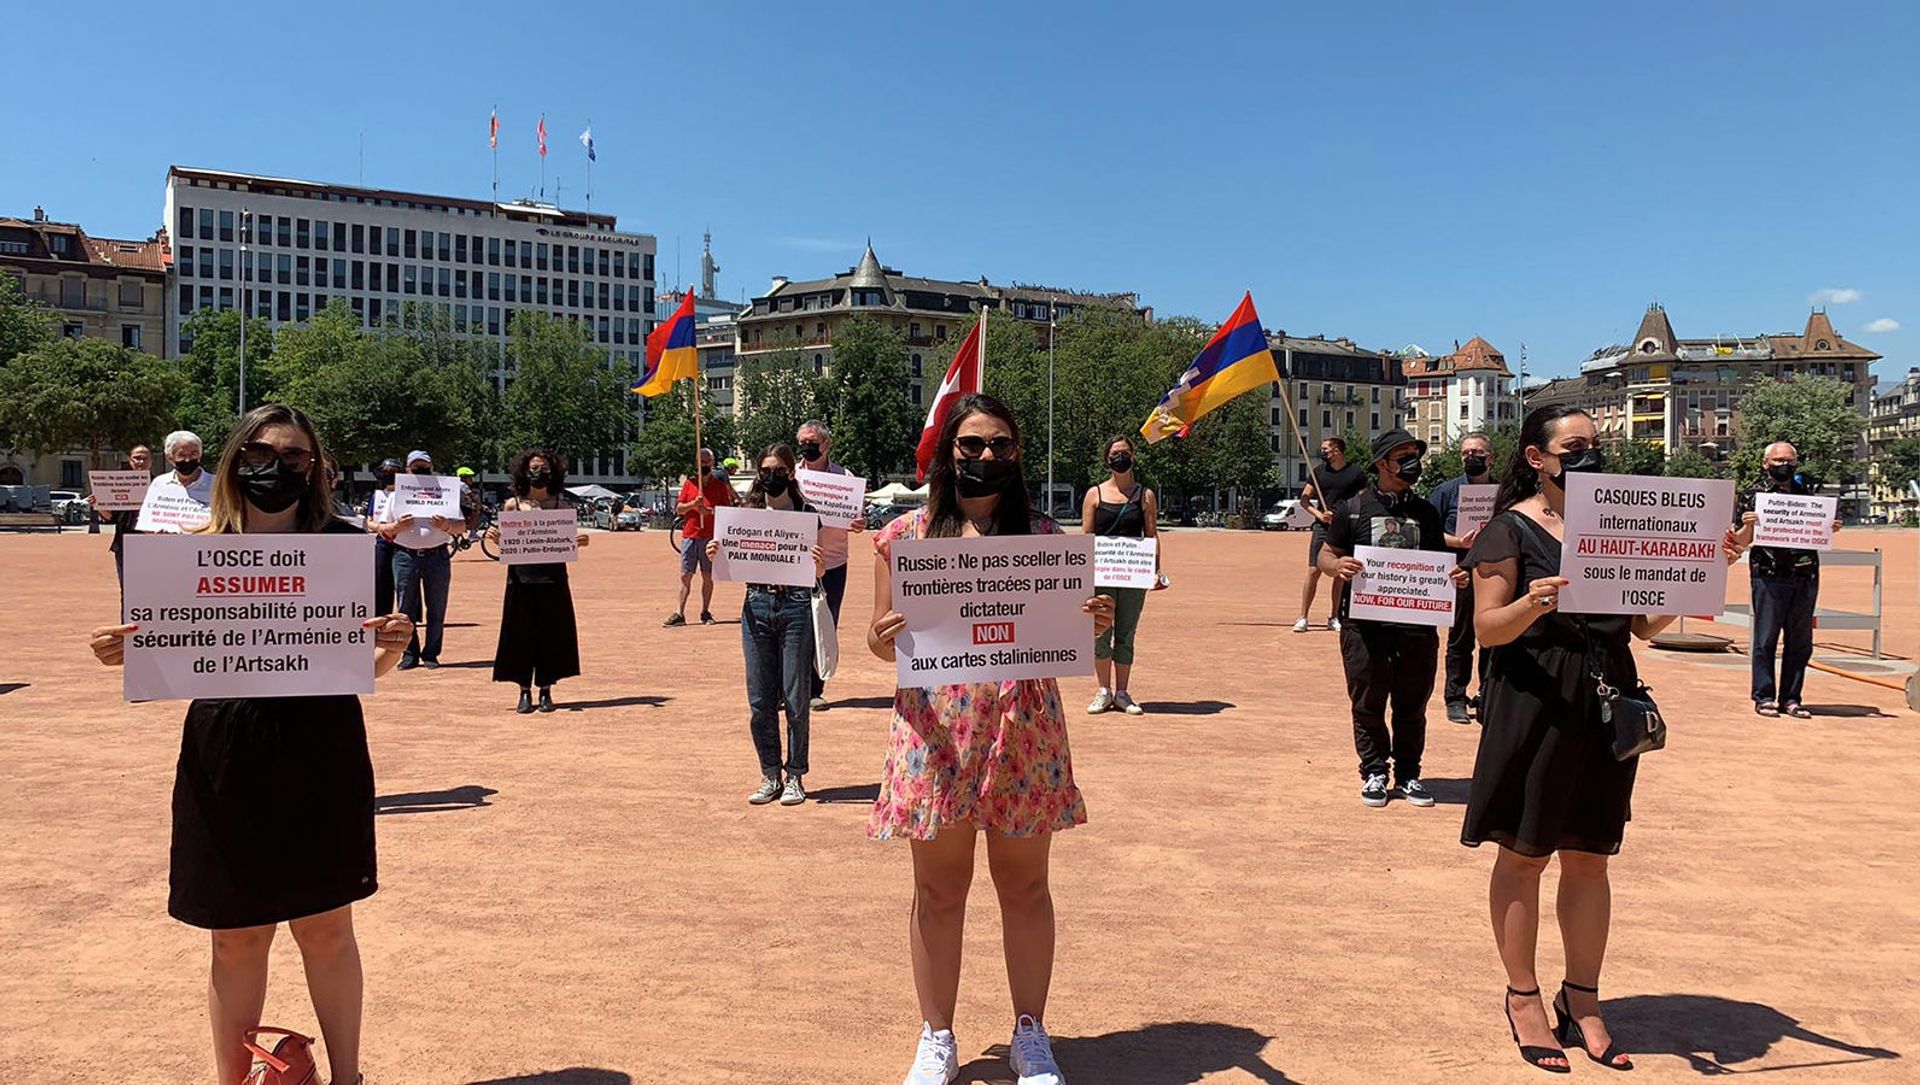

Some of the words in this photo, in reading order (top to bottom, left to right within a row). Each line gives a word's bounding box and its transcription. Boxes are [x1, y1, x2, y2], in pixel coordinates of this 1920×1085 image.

[1595, 488, 1657, 507] CASQUES
[1662, 493, 1705, 508] BLEUS
[1600, 514, 1697, 533] internationaux
[728, 526, 762, 537] Erdogan
[774, 531, 799, 540] Aliyev
[722, 539, 739, 547] Une
[741, 541, 775, 550] menace
[1578, 538, 1596, 553] AU
[1601, 540, 1716, 558] HAUT-KARABAKH
[197, 550, 264, 567] L'OSCE
[270, 550, 306, 567] doit
[729, 552, 748, 560] PAIX
[751, 553, 794, 563] MONDIALE
[898, 555, 947, 572] Russie
[958, 553, 978, 569] Ne
[982, 555, 1009, 571] pas
[1012, 551, 1061, 568] sceller
[1065, 550, 1086, 566] les
[1367, 558, 1385, 567] Your
[1387, 562, 1434, 572] recognition
[1378, 571, 1407, 583] history
[1410, 574, 1417, 583] is
[1419, 575, 1448, 587] greatly
[1584, 567, 1615, 580] sous
[1620, 565, 1630, 580] le
[1635, 566, 1685, 582] mandat
[1690, 568, 1706, 583] de
[196, 576, 306, 594] ASSUMER
[902, 578, 973, 596] frontières
[976, 576, 1031, 593] tracées
[1035, 577, 1059, 593] par
[1063, 577, 1082, 590] un
[1378, 585, 1430, 596] appreciated.
[1355, 594, 1375, 605] NOW,
[1378, 596, 1394, 606] FOR
[1397, 598, 1414, 607] OUR
[1417, 600, 1451, 610] FUTURE.
[1622, 590, 1665, 606] l'OSCE
[130, 607, 152, 621] sa
[160, 601, 297, 624] responsabilité
[303, 604, 345, 622] pour
[352, 601, 367, 619] la
[960, 602, 1025, 618] dictateur
[133, 629, 216, 648] sécurité
[222, 629, 245, 646] de
[252, 627, 342, 646] l'Arménie
[348, 628, 366, 644] et
[977, 625, 1009, 642] NON
[193, 656, 216, 673] de
[223, 655, 309, 673] l'Artsakh
[912, 656, 937, 671] aux
[942, 652, 986, 669] cartes
[990, 648, 1077, 666] staliniennes
